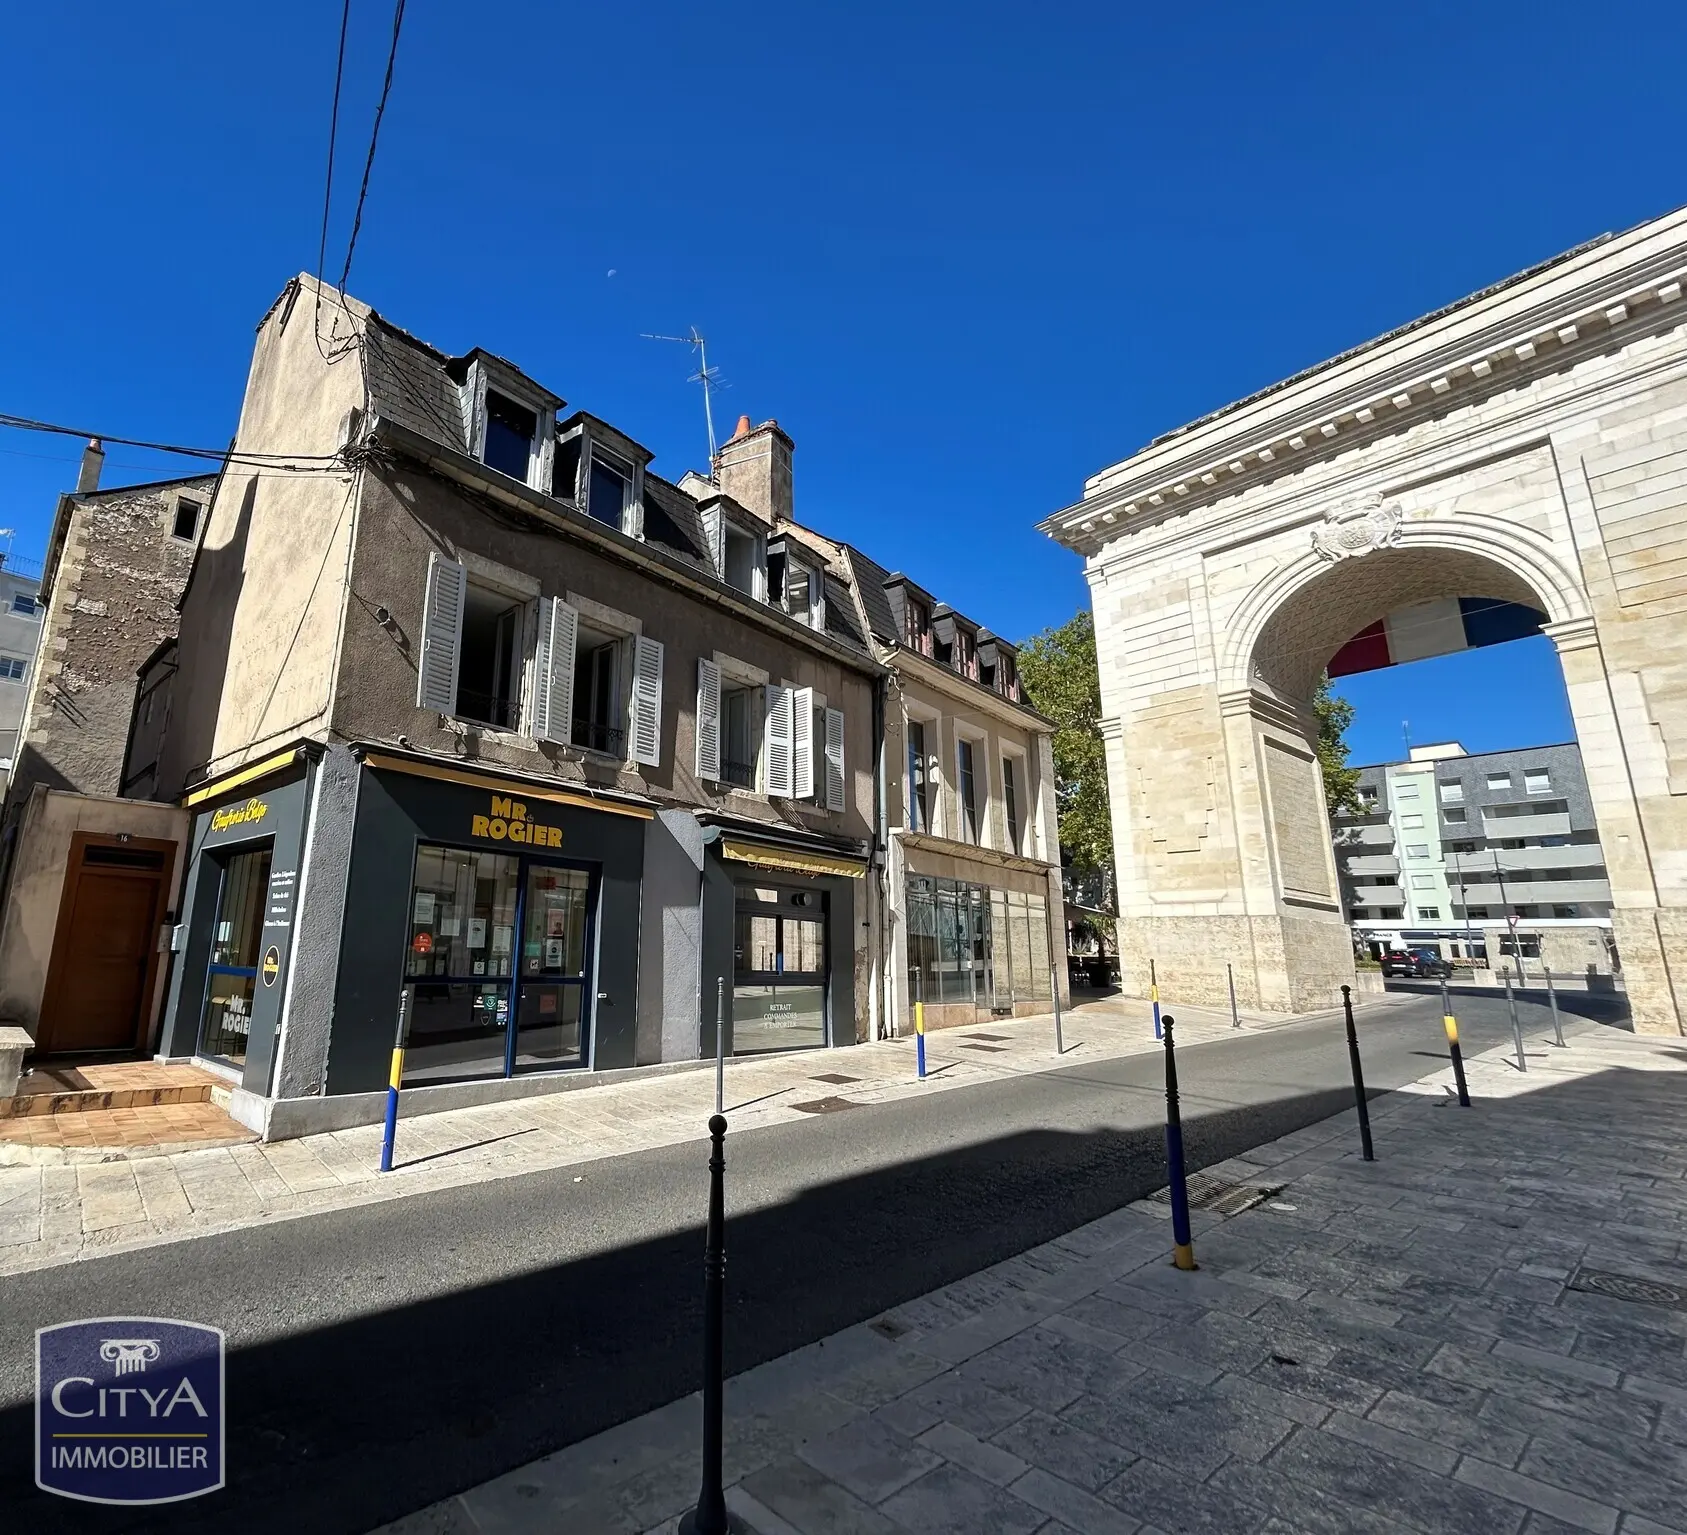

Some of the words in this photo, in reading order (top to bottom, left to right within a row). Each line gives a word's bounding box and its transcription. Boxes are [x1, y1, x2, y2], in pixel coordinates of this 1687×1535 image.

[472, 814, 562, 847] ROGIER
[120, 834, 128, 842] 16
[770, 1003, 792, 1011] RETRAIT
[763, 1012, 798, 1020] COMMANDES
[222, 1011, 250, 1035] ROGIE
